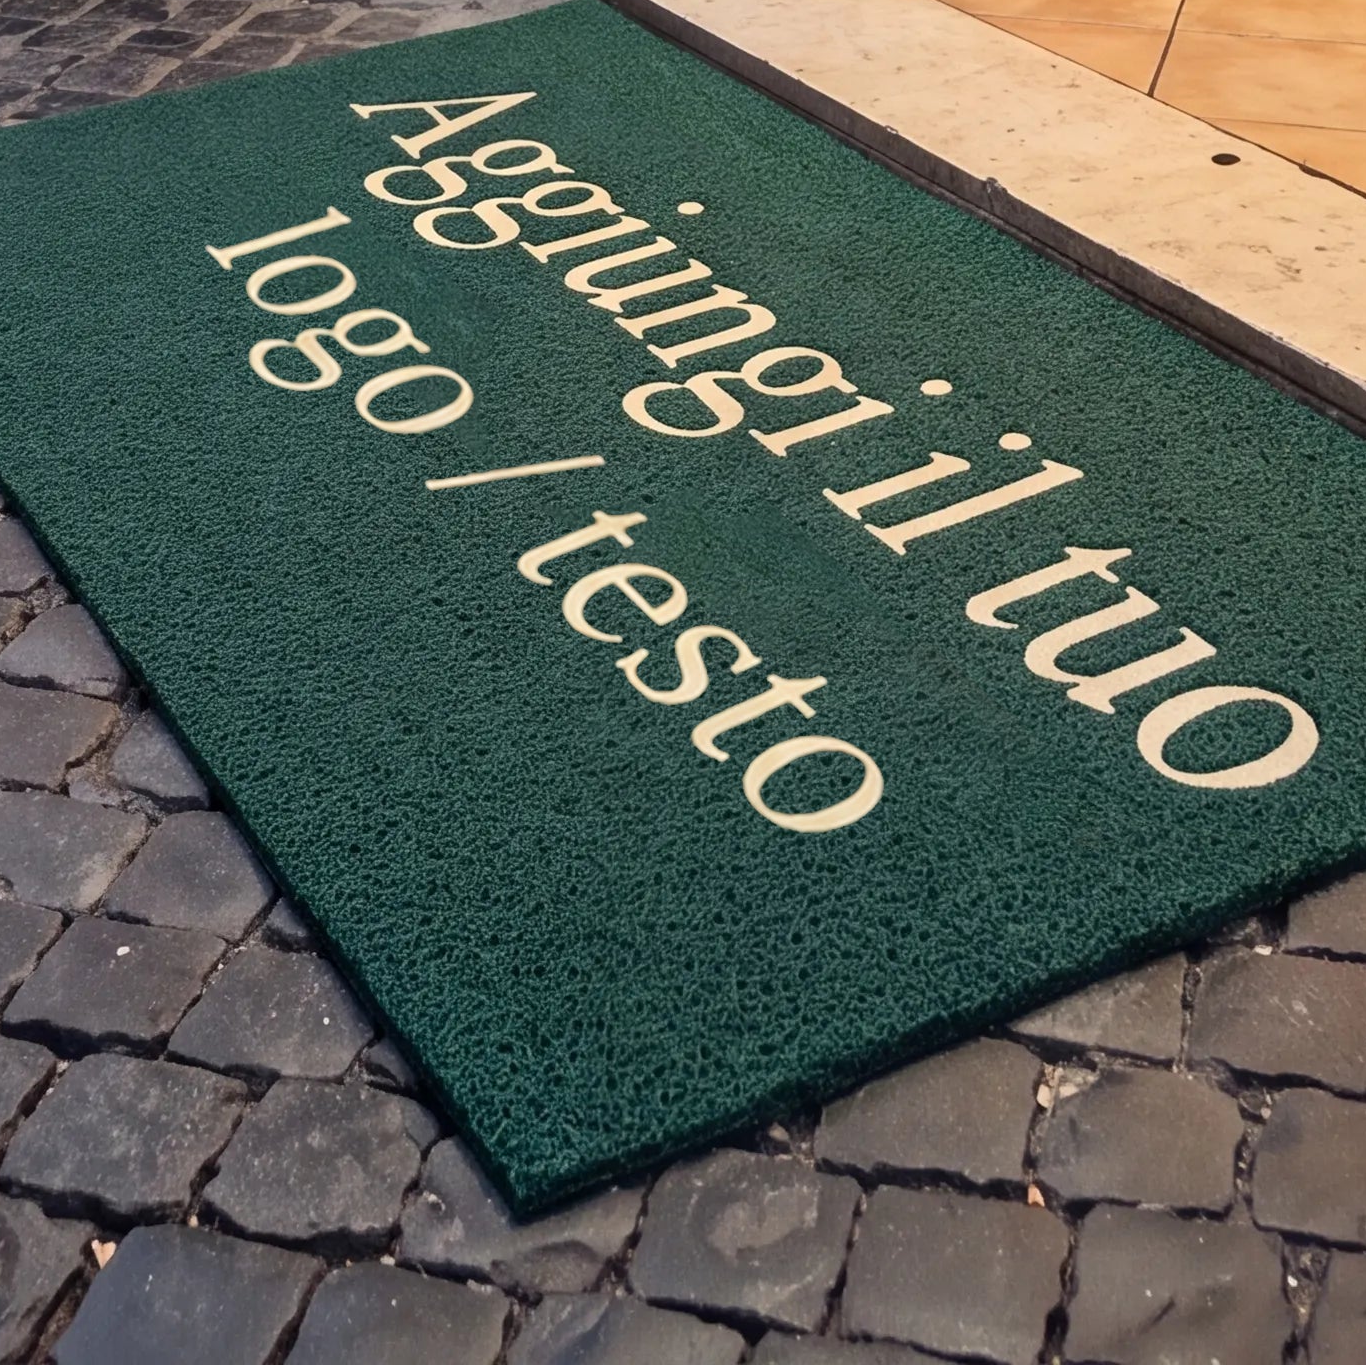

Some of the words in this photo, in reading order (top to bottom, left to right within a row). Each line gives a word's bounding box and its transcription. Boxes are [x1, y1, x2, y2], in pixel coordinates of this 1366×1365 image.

[206, 206, 475, 436] logo
[425, 454, 606, 492] /
[516, 510, 885, 834] testo
[348, 91, 953, 459] Aggiungi
[822, 432, 1084, 557] il
[965, 546, 1321, 791] tuo
